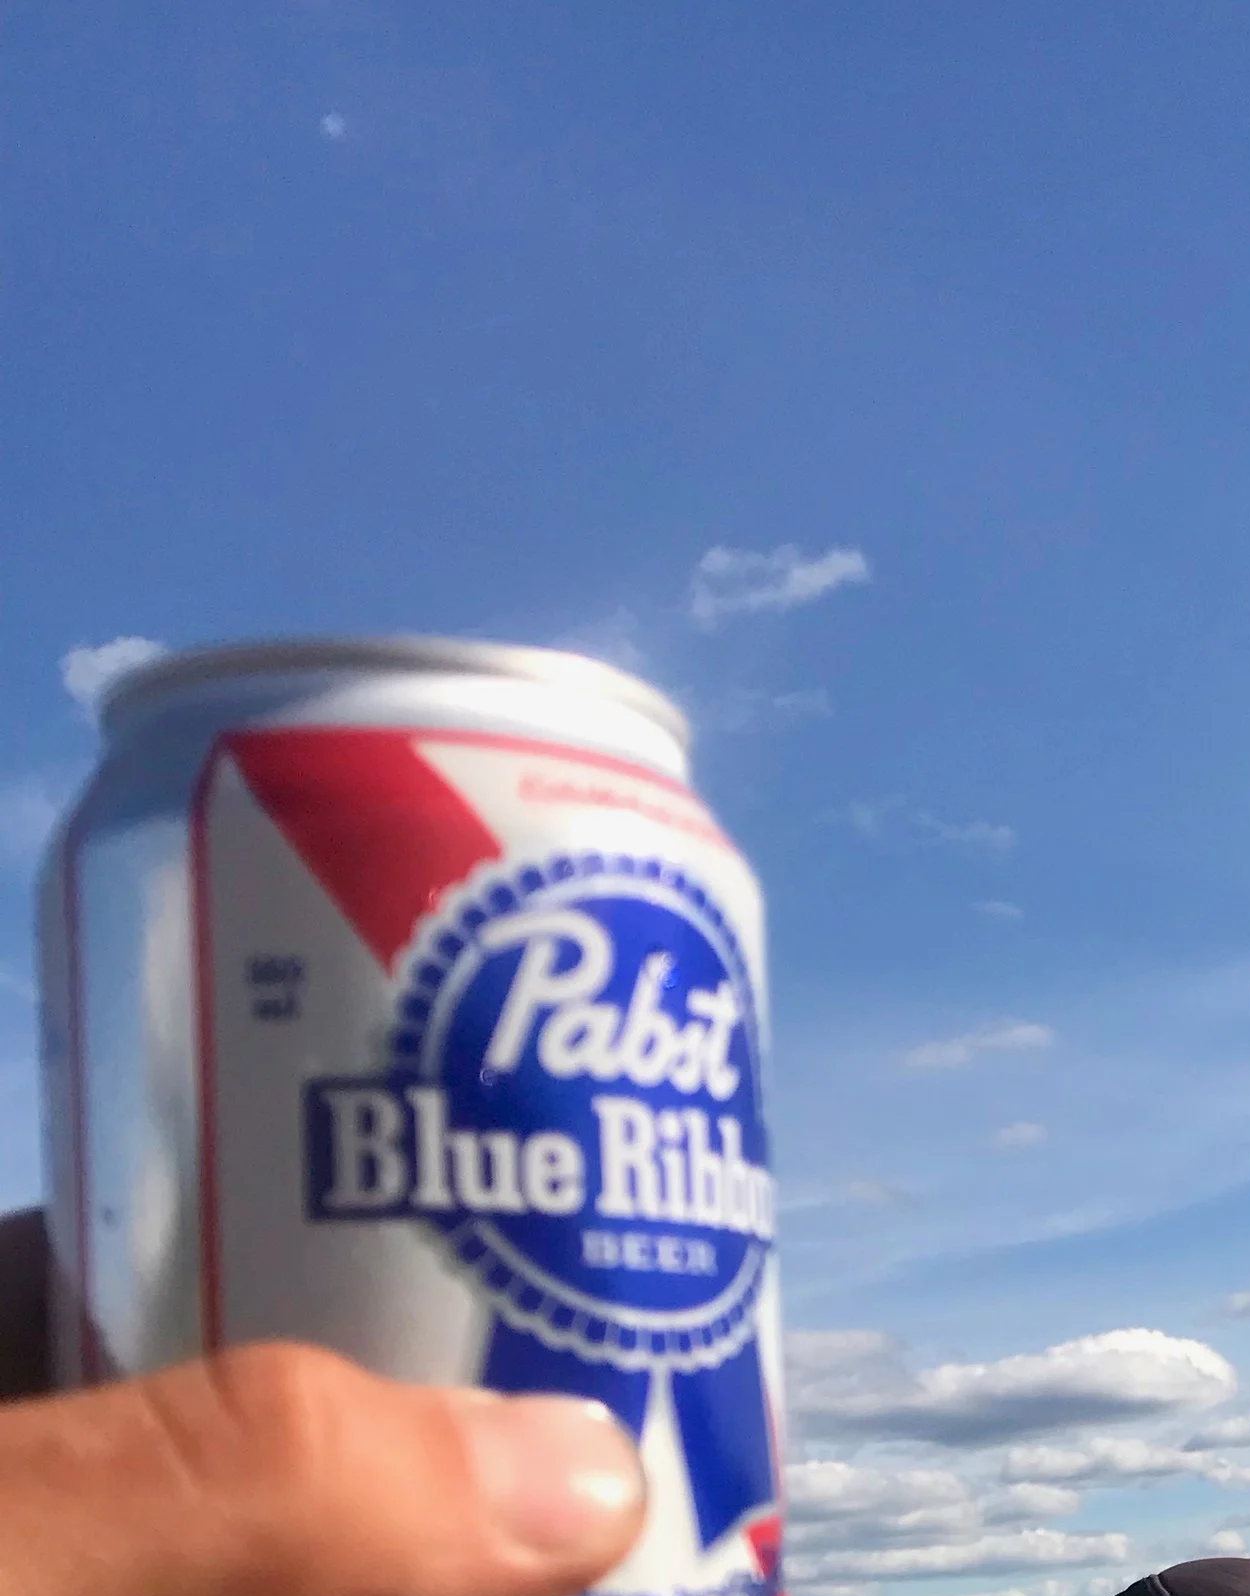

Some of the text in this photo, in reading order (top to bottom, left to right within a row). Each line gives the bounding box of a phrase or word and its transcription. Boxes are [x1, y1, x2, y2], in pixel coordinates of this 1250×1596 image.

[480, 907, 740, 1101] Pabst
[320, 1087, 586, 1216] Blue
[579, 1229, 718, 1276] BEER
